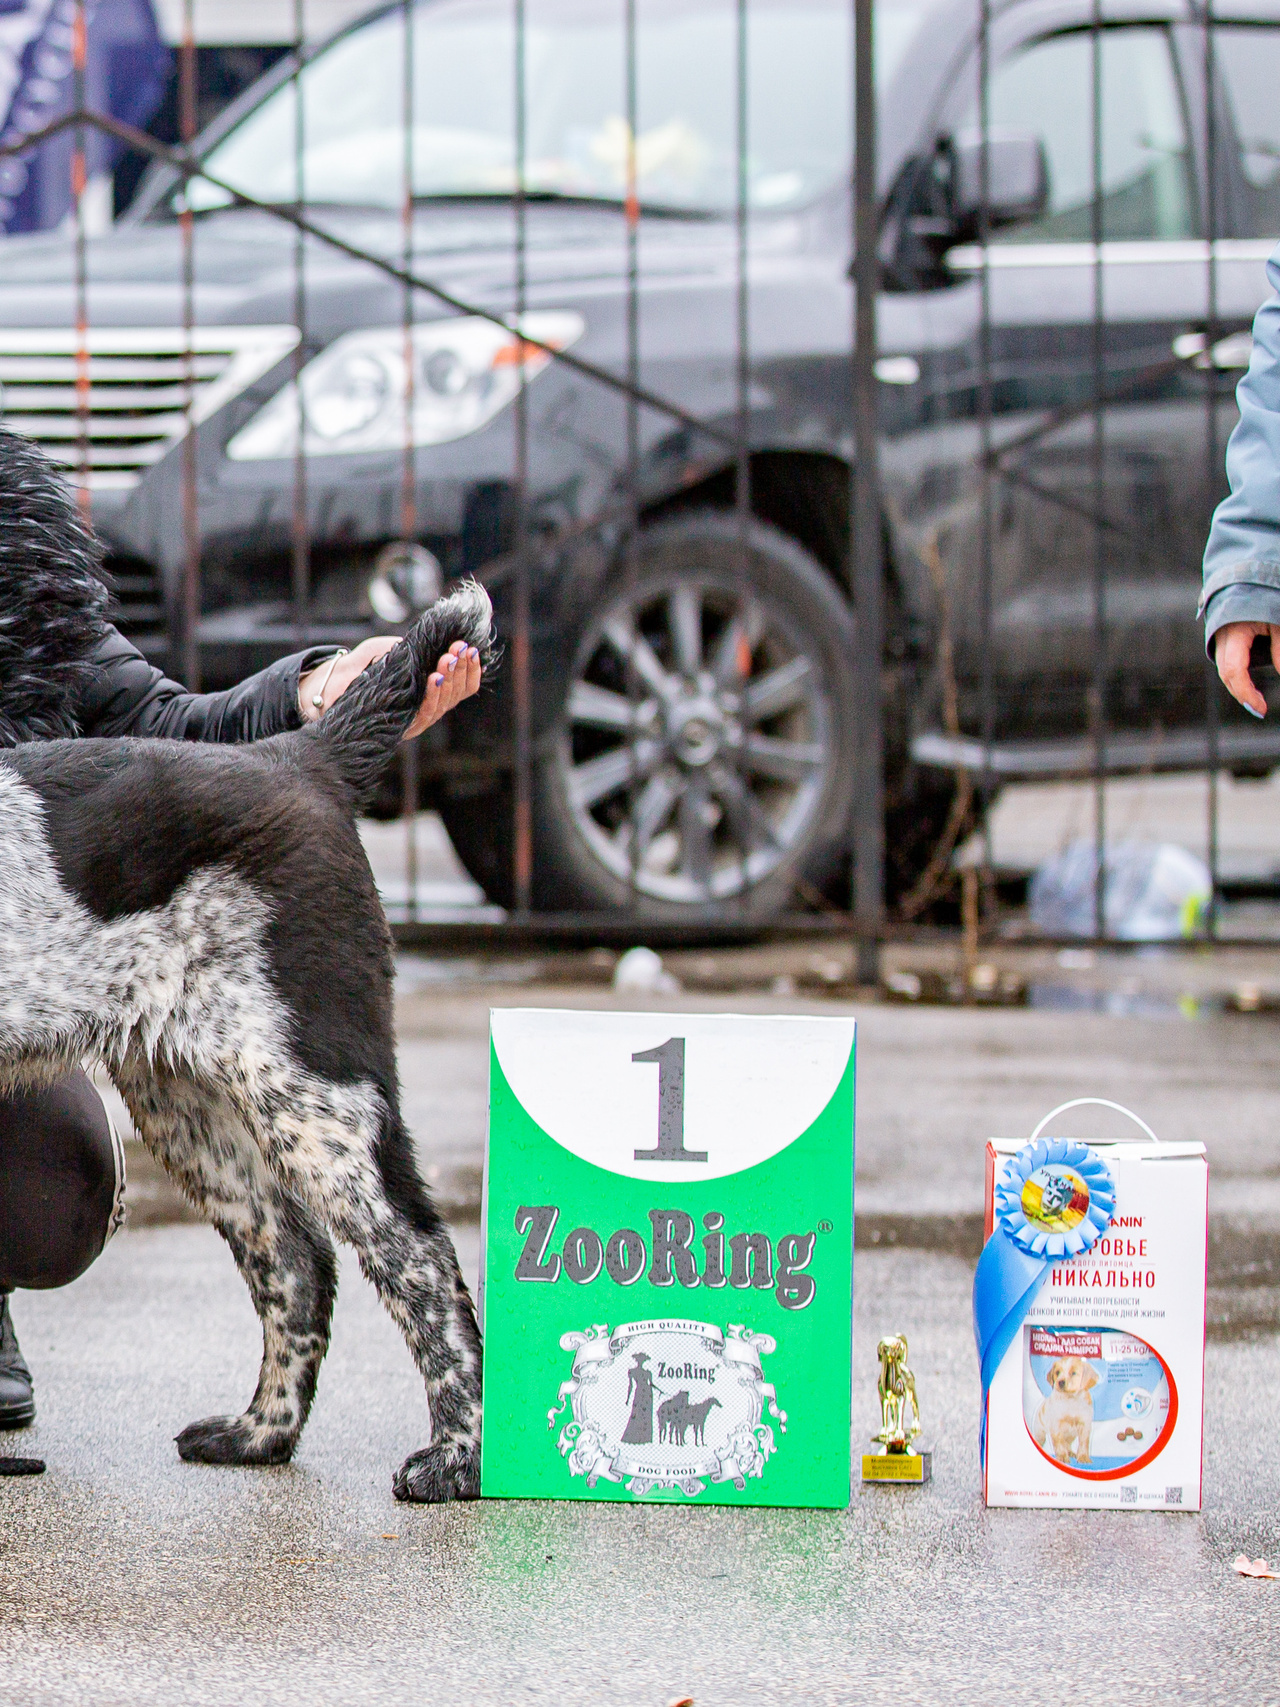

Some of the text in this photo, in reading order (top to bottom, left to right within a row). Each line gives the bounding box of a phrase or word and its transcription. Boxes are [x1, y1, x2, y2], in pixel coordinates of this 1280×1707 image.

[631, 1036, 709, 1163] 1
[1108, 1216, 1143, 1228] ANIN
[1076, 1238, 1147, 1257] РОВЬЕ
[514, 1205, 817, 1310] ZooRing
[1061, 1259, 1133, 1268] КАЖДОГО ПИТОМЦА
[1043, 1268, 1156, 1289] НИКАЛЬНО
[1050, 1296, 1140, 1306] УЧИТЫВАЕМ ПОТРЕБНОСТИ
[1056, 1308, 1062, 1316] И
[1063, 1308, 1084, 1316] КОТЯТ
[1085, 1308, 1090, 1316] С
[1091, 1308, 1119, 1317] ПЕРВЫХ
[1120, 1308, 1139, 1319] ДНЕЙ
[1140, 1310, 1166, 1319] ЖИЗНИ
[627, 1322, 707, 1333] HIGH QUALITY
[1110, 1345, 1132, 1354] 11-25
[658, 1362, 715, 1384] ZooRing
[639, 1466, 661, 1475] DOG
